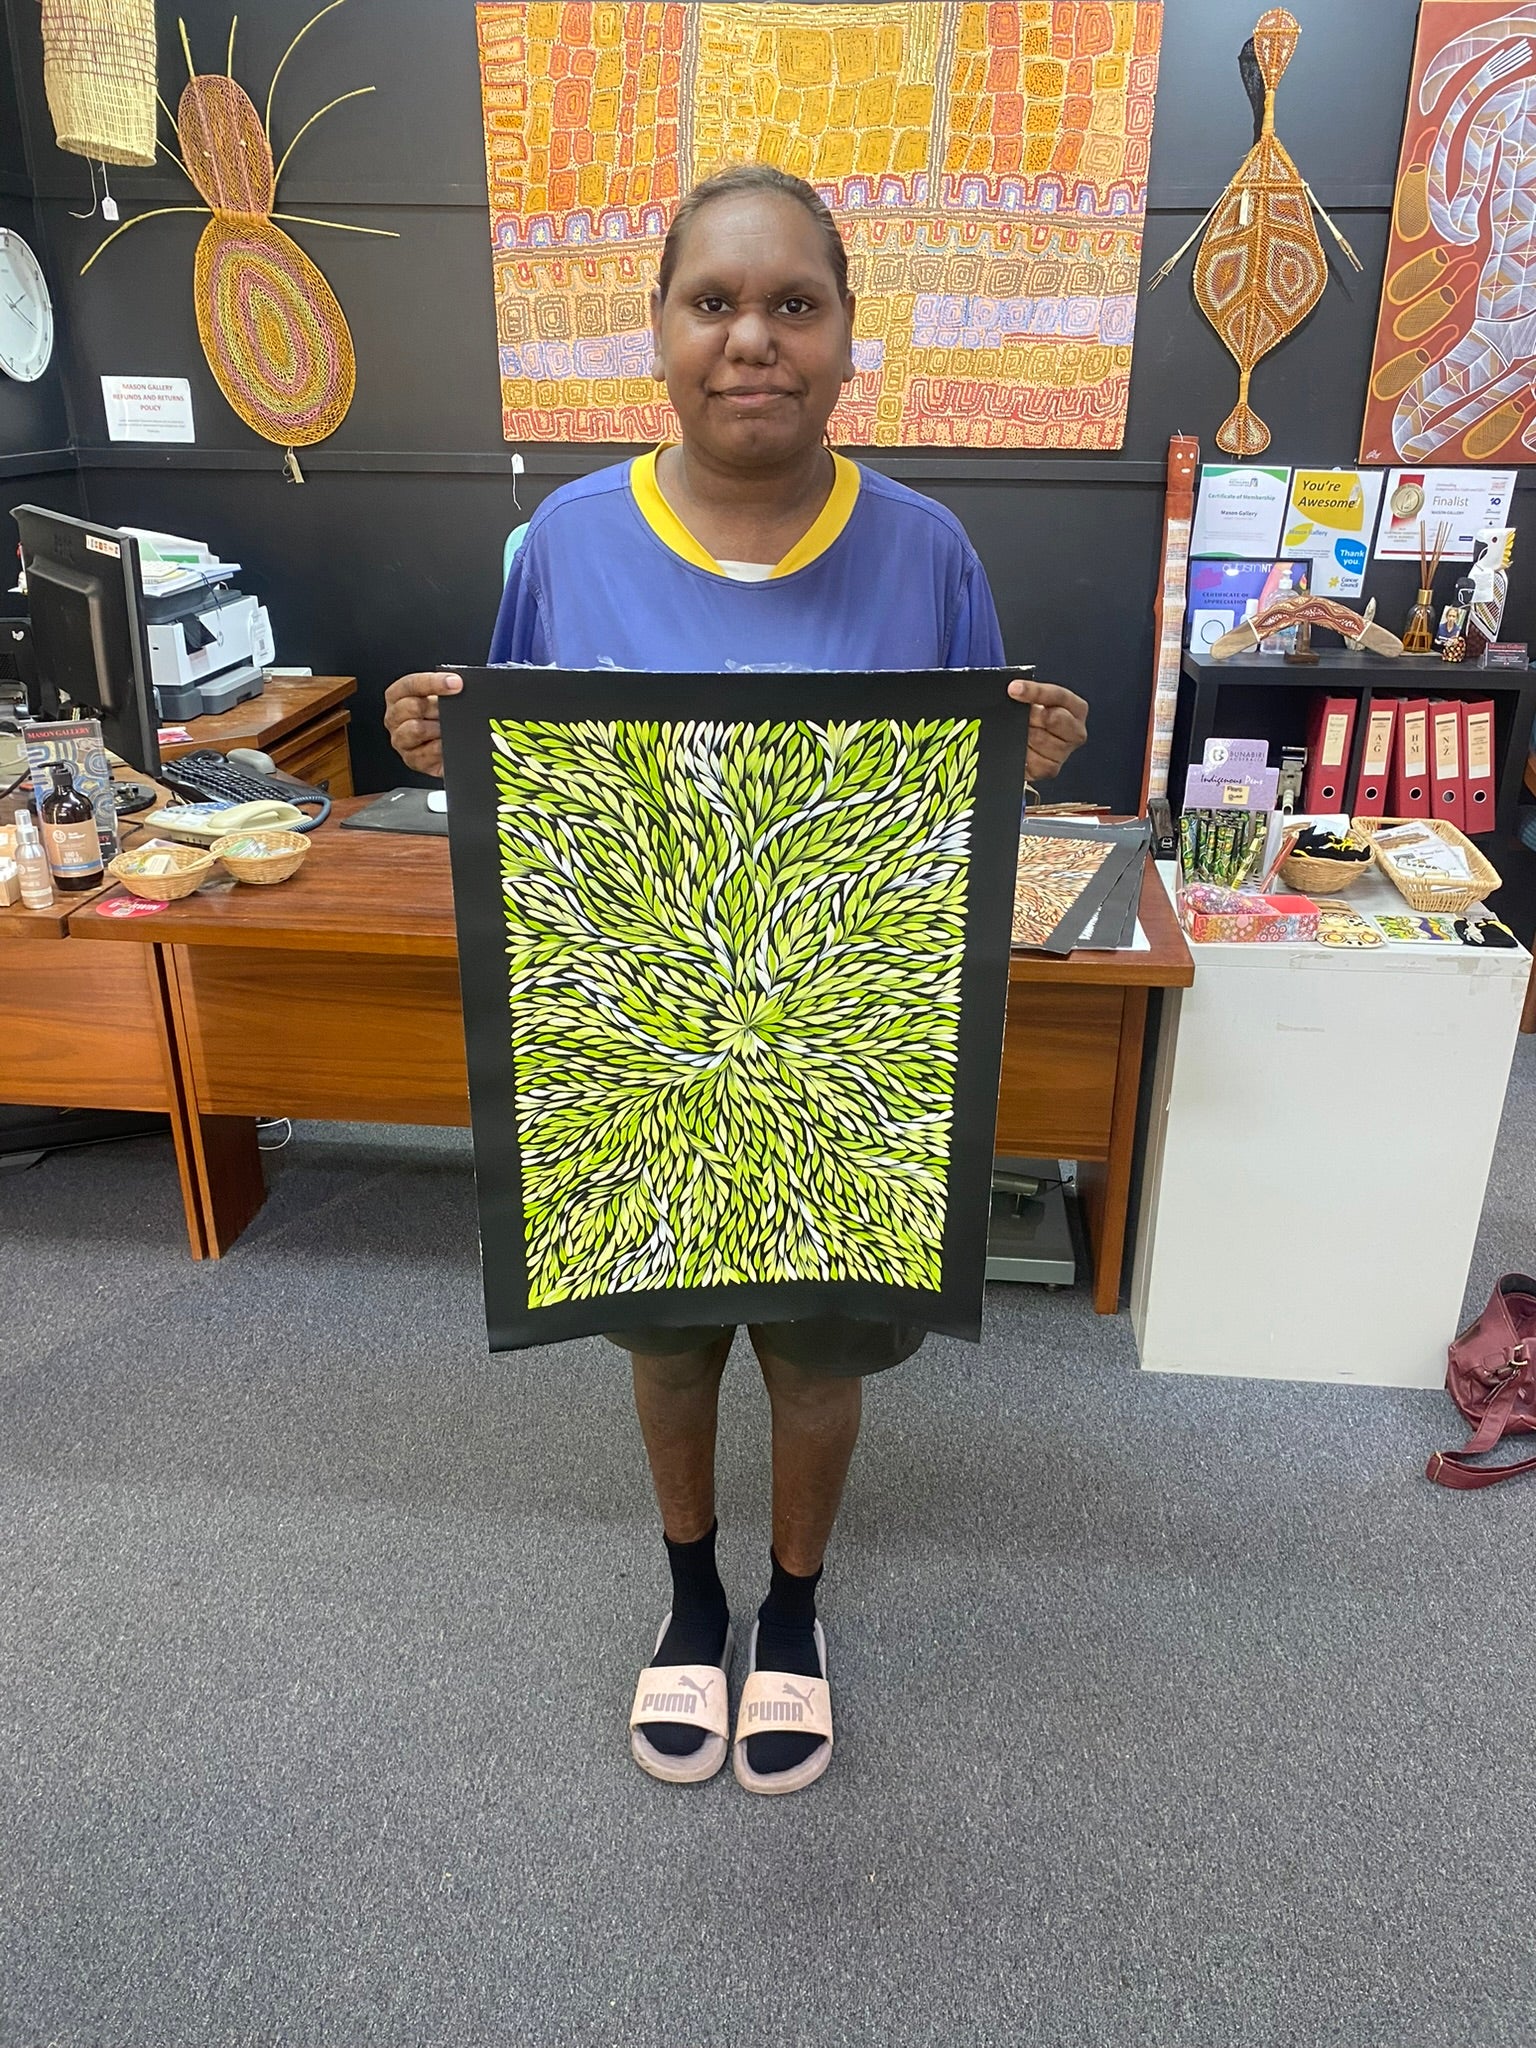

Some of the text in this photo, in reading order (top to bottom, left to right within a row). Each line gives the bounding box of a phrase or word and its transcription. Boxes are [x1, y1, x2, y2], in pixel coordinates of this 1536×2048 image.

[1303, 480, 1341, 492] You're
[1208, 492, 1236, 500] Certificate
[1432, 496, 1469, 507] Finalist
[1238, 510, 1258, 518] Gallery
[1340, 549, 1365, 558] Thank
[1343, 558, 1360, 567] you.
[27, 727, 91, 739] MASON GALLERY
[1412, 734, 1419, 742] H
[1443, 736, 1450, 744] N
[1373, 744, 1381, 752] G
[1411, 745, 1419, 753] M
[1443, 748, 1450, 756] Z
[1201, 774, 1264, 787] Indigenous Pens
[642, 1693, 697, 1714] PUMA
[748, 1701, 804, 1722] PUMA
